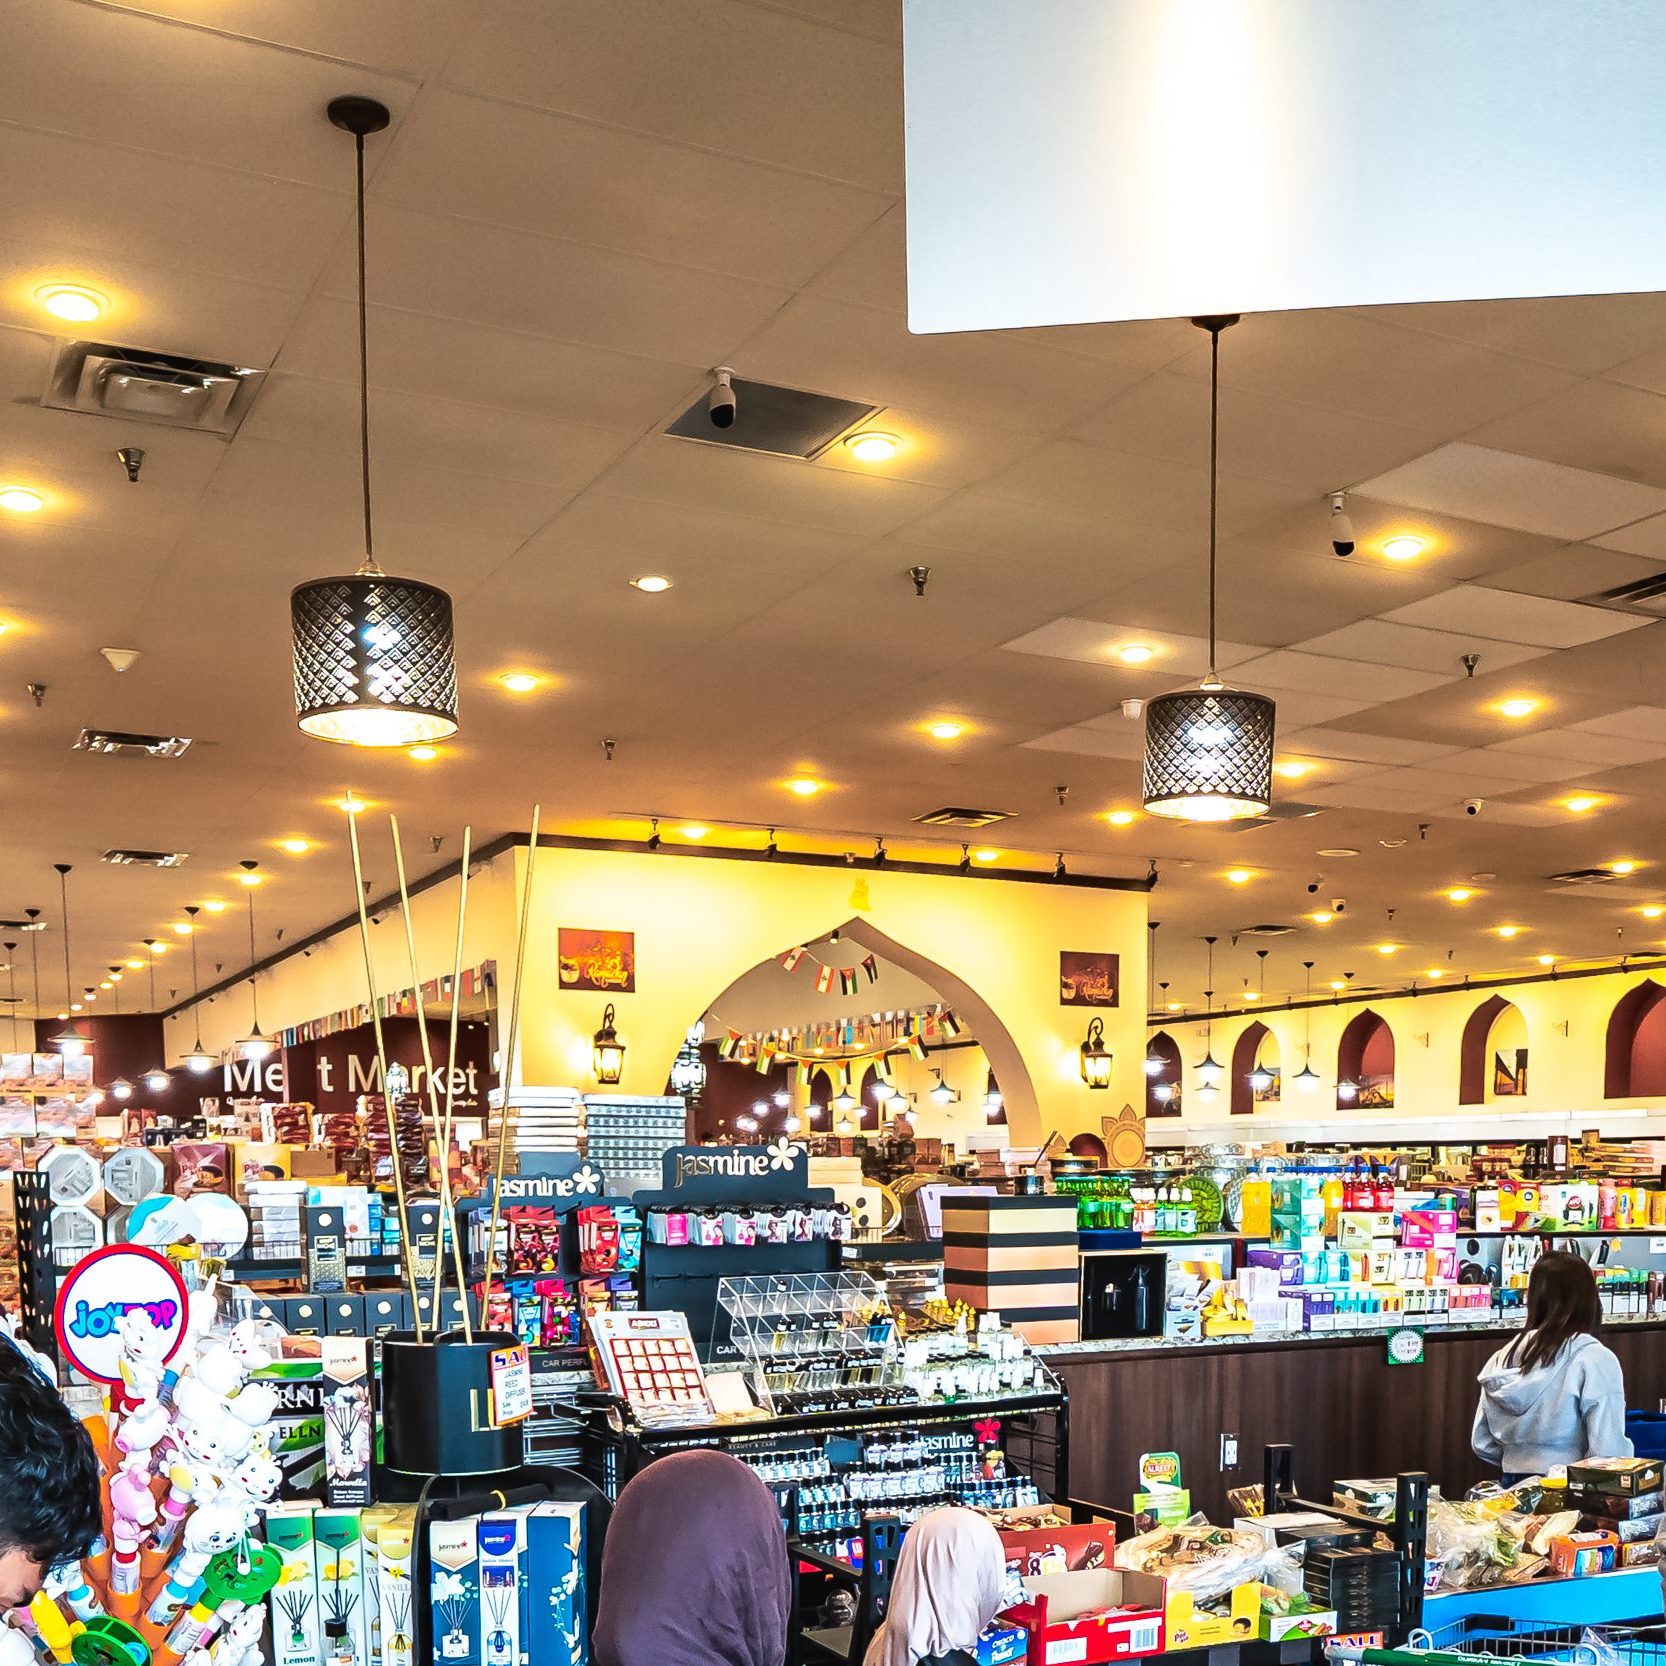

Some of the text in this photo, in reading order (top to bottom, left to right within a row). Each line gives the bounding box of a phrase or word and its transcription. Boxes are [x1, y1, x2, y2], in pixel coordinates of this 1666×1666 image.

[223, 1056, 334, 1093] Met
[541, 1359, 560, 1368] CAR
[283, 1655, 316, 1665] Lemon
